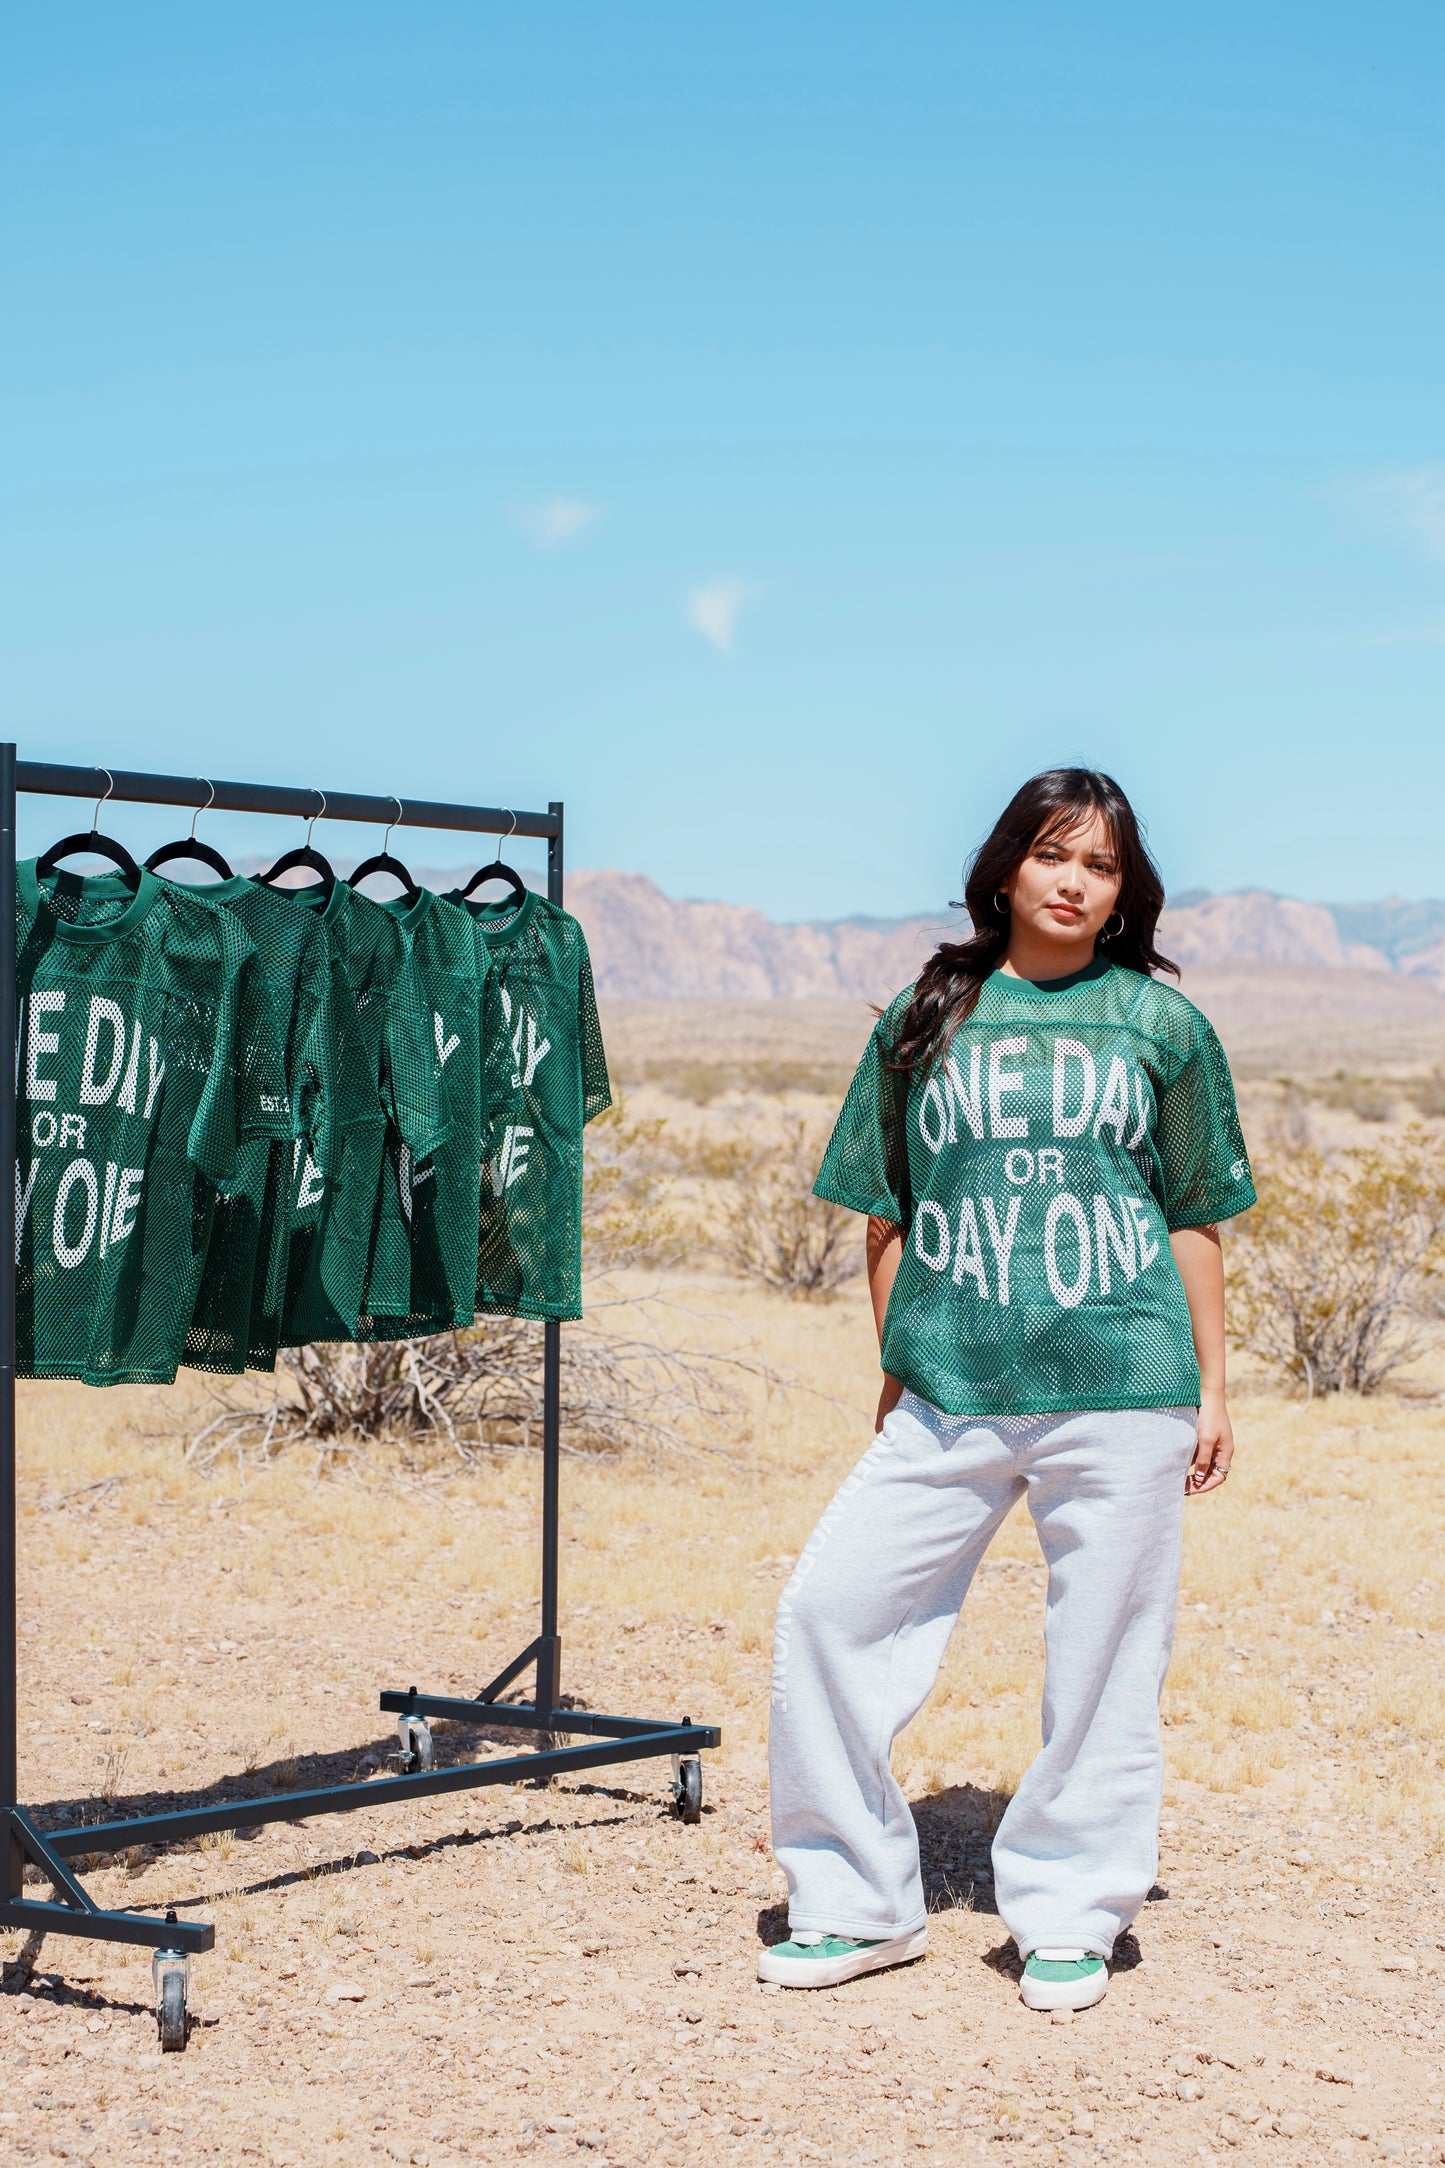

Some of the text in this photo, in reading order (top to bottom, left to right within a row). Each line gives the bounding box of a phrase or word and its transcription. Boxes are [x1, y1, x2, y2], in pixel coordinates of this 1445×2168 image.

[33, 1111, 87, 1149] OR
[919, 1036, 1150, 1154] ONE DAY
[1005, 1148, 1065, 1185] OR
[916, 1192, 1159, 1308] DAY ONE
